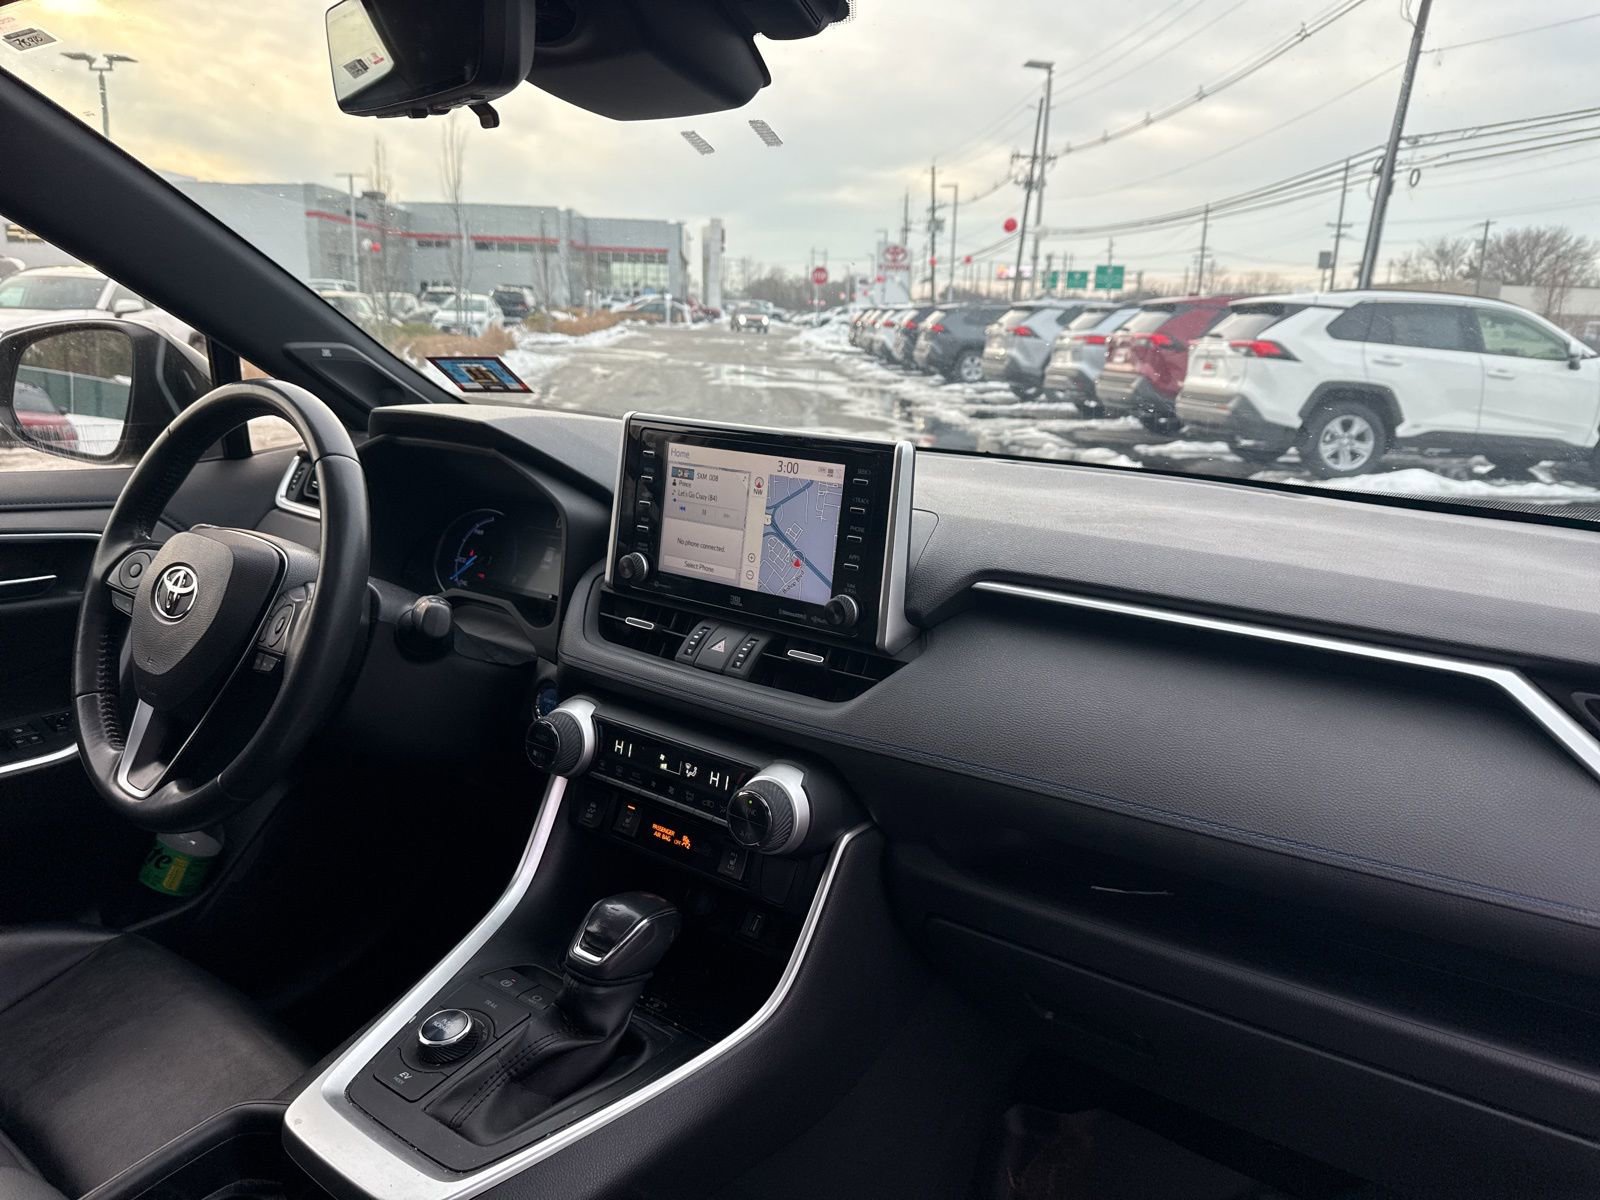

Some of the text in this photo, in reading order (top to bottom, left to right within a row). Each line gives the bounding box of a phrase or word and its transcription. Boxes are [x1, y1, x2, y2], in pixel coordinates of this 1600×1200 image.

[670, 448, 690, 459] Home
[777, 460, 799, 474] 3:00
[753, 488, 763, 496] NW
[677, 537, 726, 553] No phone connected.
[684, 560, 714, 572] Select Phone
[614, 739, 633, 758] HI
[709, 770, 730, 791] HI
[652, 823, 675, 837] PASSENGER
[653, 830, 671, 843] AIR BAG
[398, 1071, 413, 1080] EV
